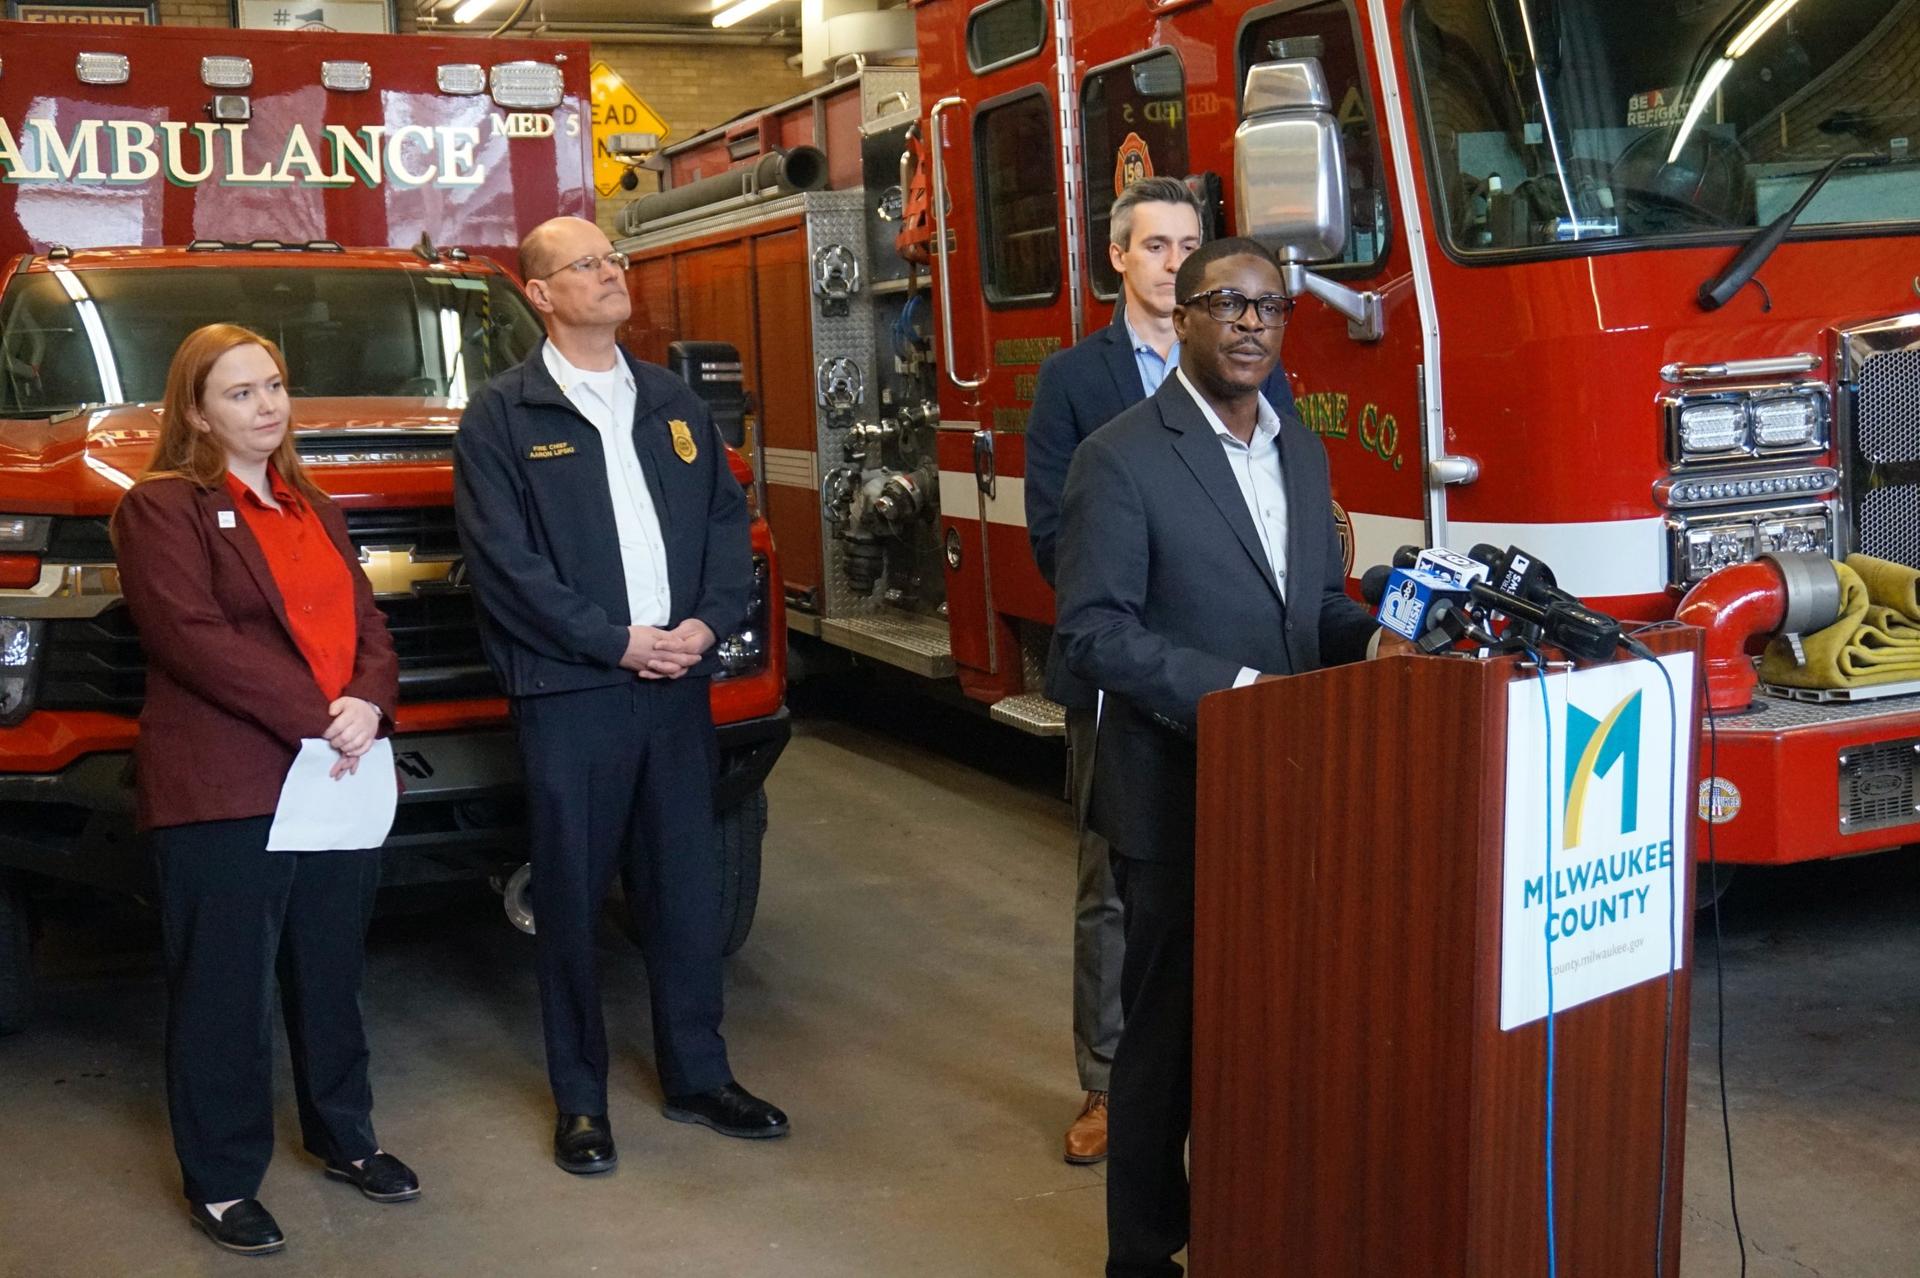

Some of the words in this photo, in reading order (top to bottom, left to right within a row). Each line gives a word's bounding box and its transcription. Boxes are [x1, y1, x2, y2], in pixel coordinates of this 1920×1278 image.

[491, 112, 554, 137] MED
[566, 113, 579, 136] 5
[592, 104, 637, 125] EAD
[1500, 570, 1515, 592] TRUM
[1506, 573, 1522, 596] EWS
[1403, 601, 1422, 635] WISN
[1523, 839, 1672, 908] MLWAUKEE
[1544, 884, 1650, 943] COUNTY
